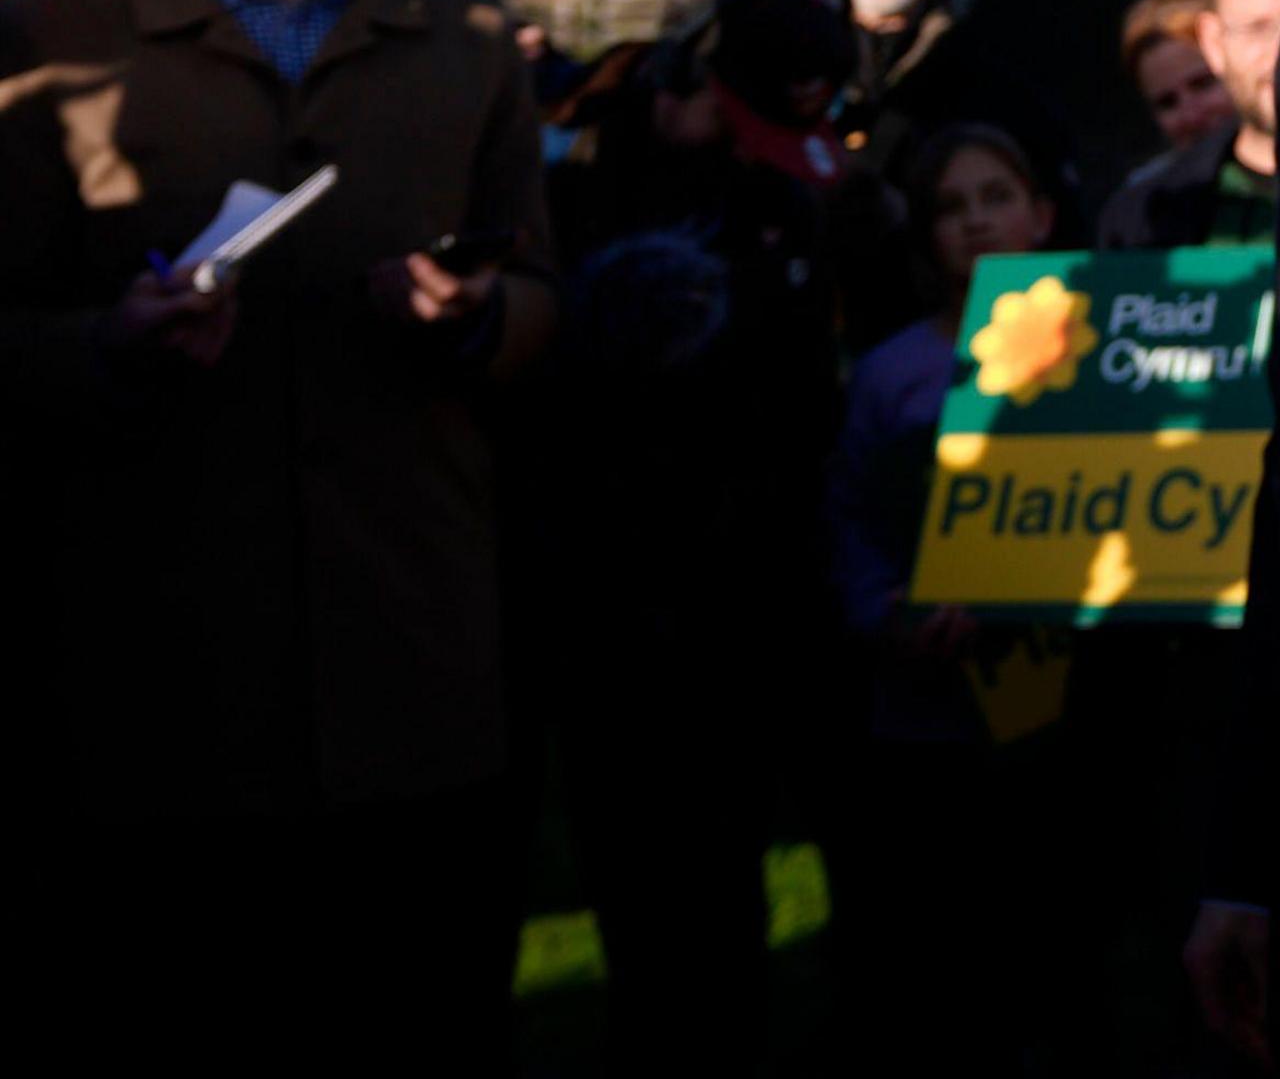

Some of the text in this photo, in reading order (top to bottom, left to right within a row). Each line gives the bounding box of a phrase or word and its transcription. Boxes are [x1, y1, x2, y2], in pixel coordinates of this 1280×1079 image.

[1108, 292, 1218, 337] Plaid
[1100, 338, 1248, 391] Cymru
[938, 468, 1249, 550] Plaid Cy
